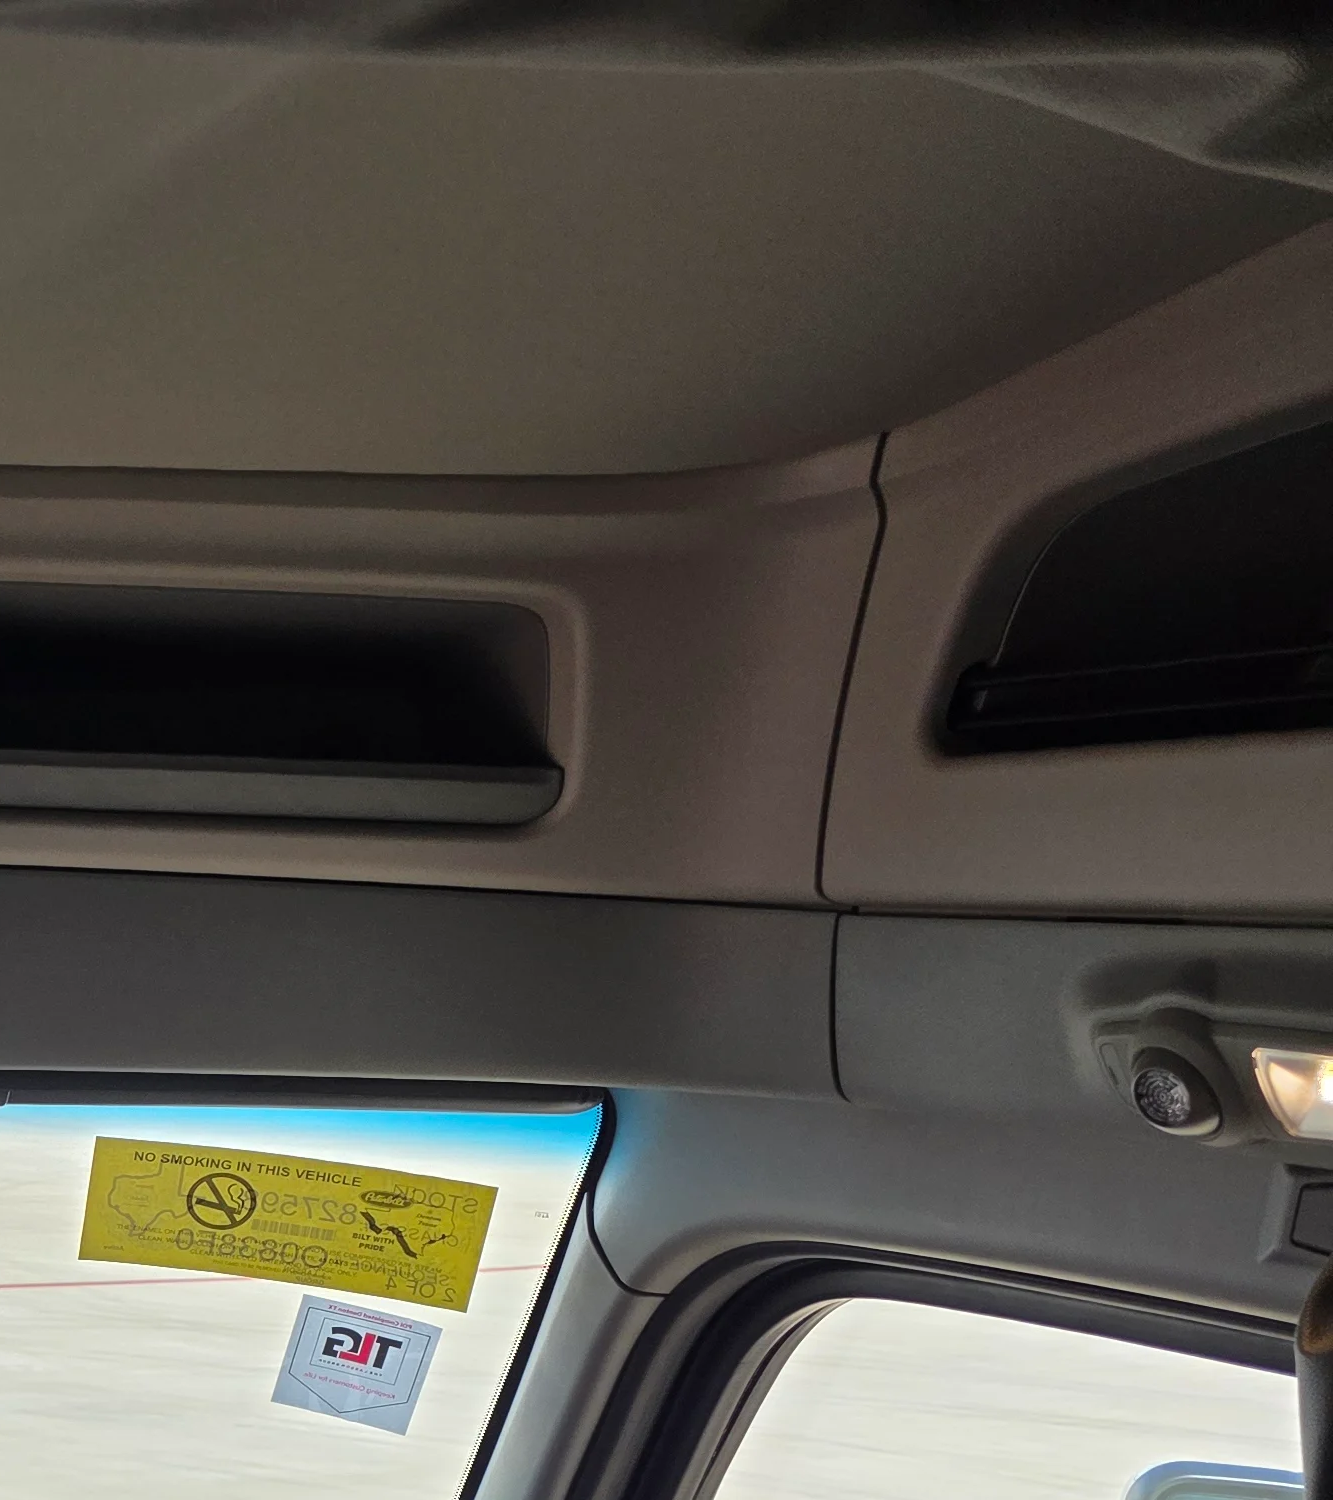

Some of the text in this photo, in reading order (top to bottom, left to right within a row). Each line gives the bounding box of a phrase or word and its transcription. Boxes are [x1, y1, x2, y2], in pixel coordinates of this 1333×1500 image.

[134, 1150, 362, 1188] NO SMOKING IN THIS VEHICLE
[352, 1232, 395, 1246] BILT WITH
[358, 1242, 386, 1253] PRIDE
